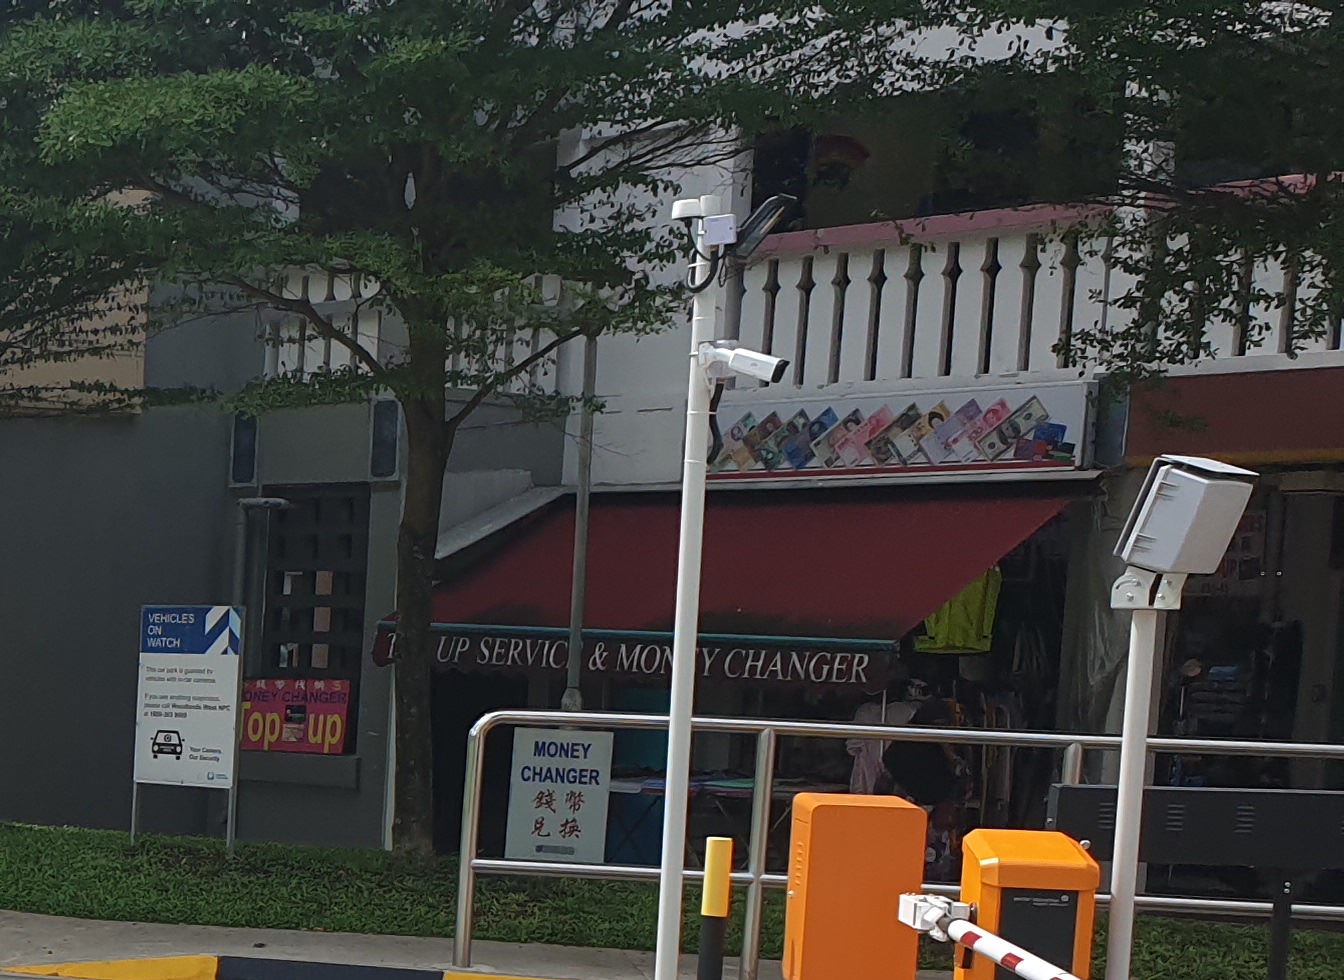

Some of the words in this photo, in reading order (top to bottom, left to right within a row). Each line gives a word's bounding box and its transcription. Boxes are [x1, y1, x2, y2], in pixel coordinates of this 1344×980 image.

[148, 613, 195, 624] VEHICLES
[147, 625, 162, 635] ON
[146, 637, 181, 648] WATCH
[436, 635, 471, 663] UP
[476, 636, 570, 670] SERVIC
[587, 641, 609, 672] &
[615, 642, 720, 678] MONY
[723, 647, 870, 684] CHANGER
[243, 691, 279, 702] ONEY
[282, 692, 348, 705] CHANGER
[307, 713, 343, 754] up
[533, 740, 593, 760] MONEY
[520, 765, 601, 786] CHANGER
